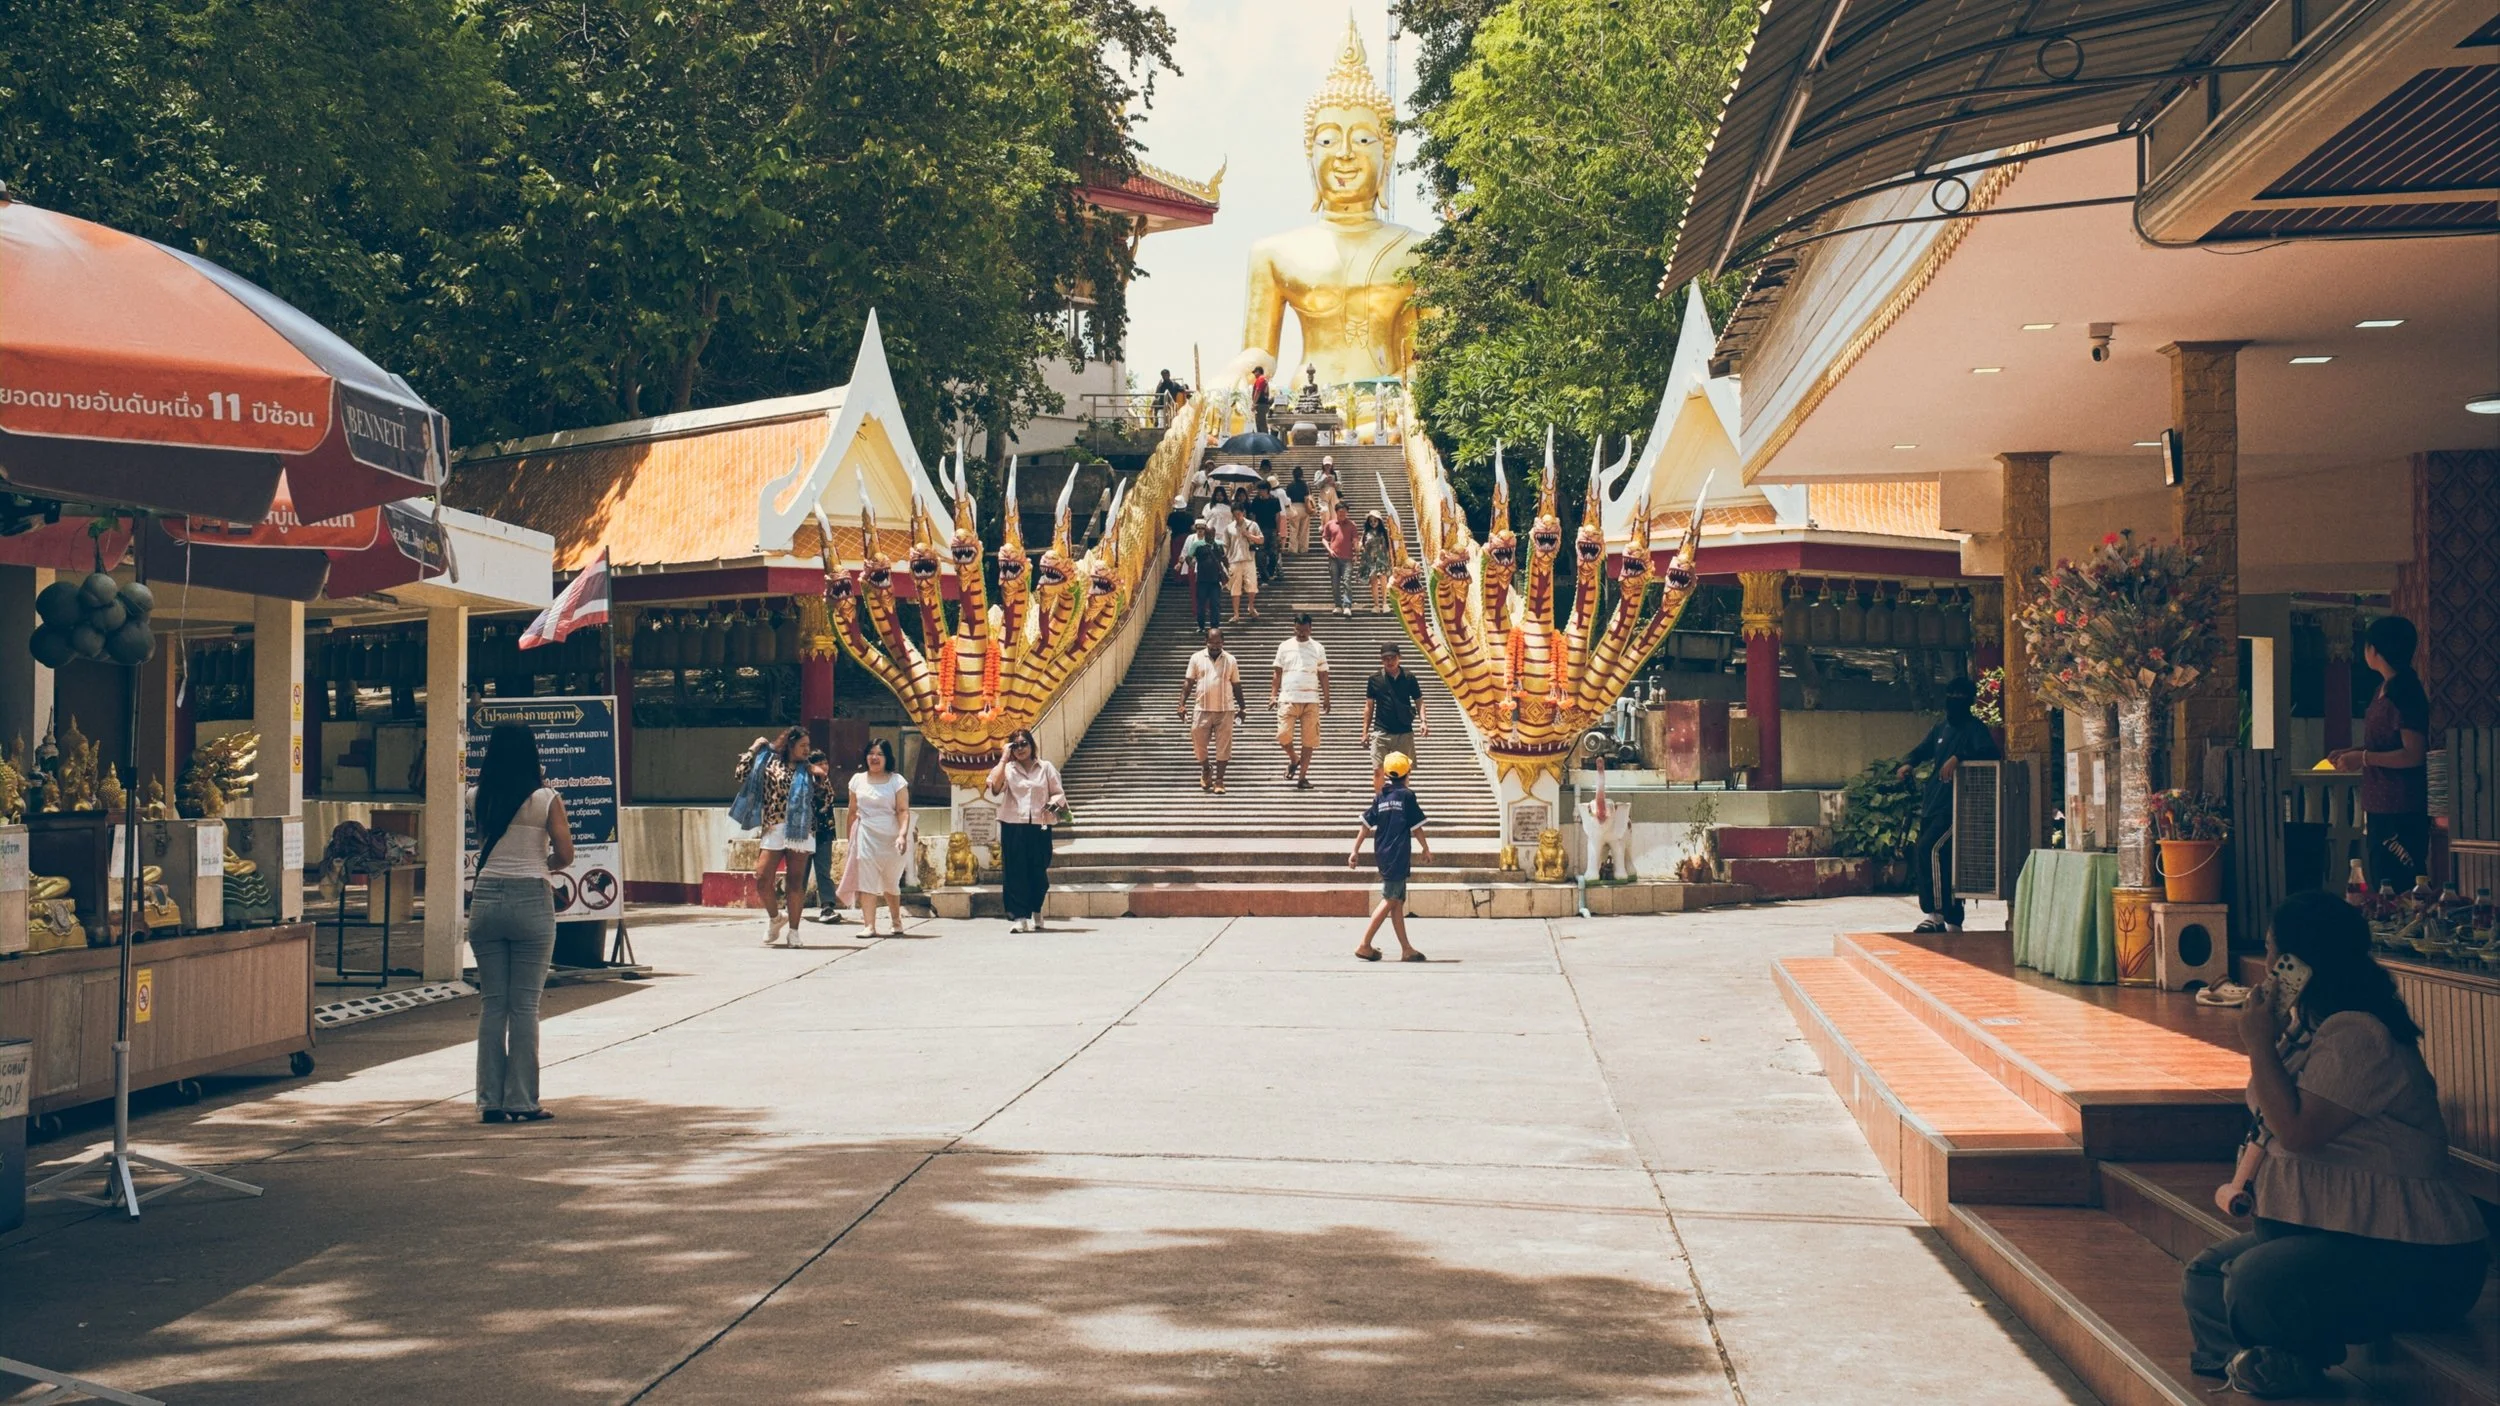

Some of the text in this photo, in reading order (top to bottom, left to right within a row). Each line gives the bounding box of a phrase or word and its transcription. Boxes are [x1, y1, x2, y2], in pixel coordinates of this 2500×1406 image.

[0, 388, 314, 427] ยอดขายอันดับหนึ่ง 11 ปีซ้อน
[347, 405, 407, 452] BENNETT
[551, 778, 568, 787] place
[569, 777, 580, 787] for
[580, 776, 612, 786] Buddhism.
